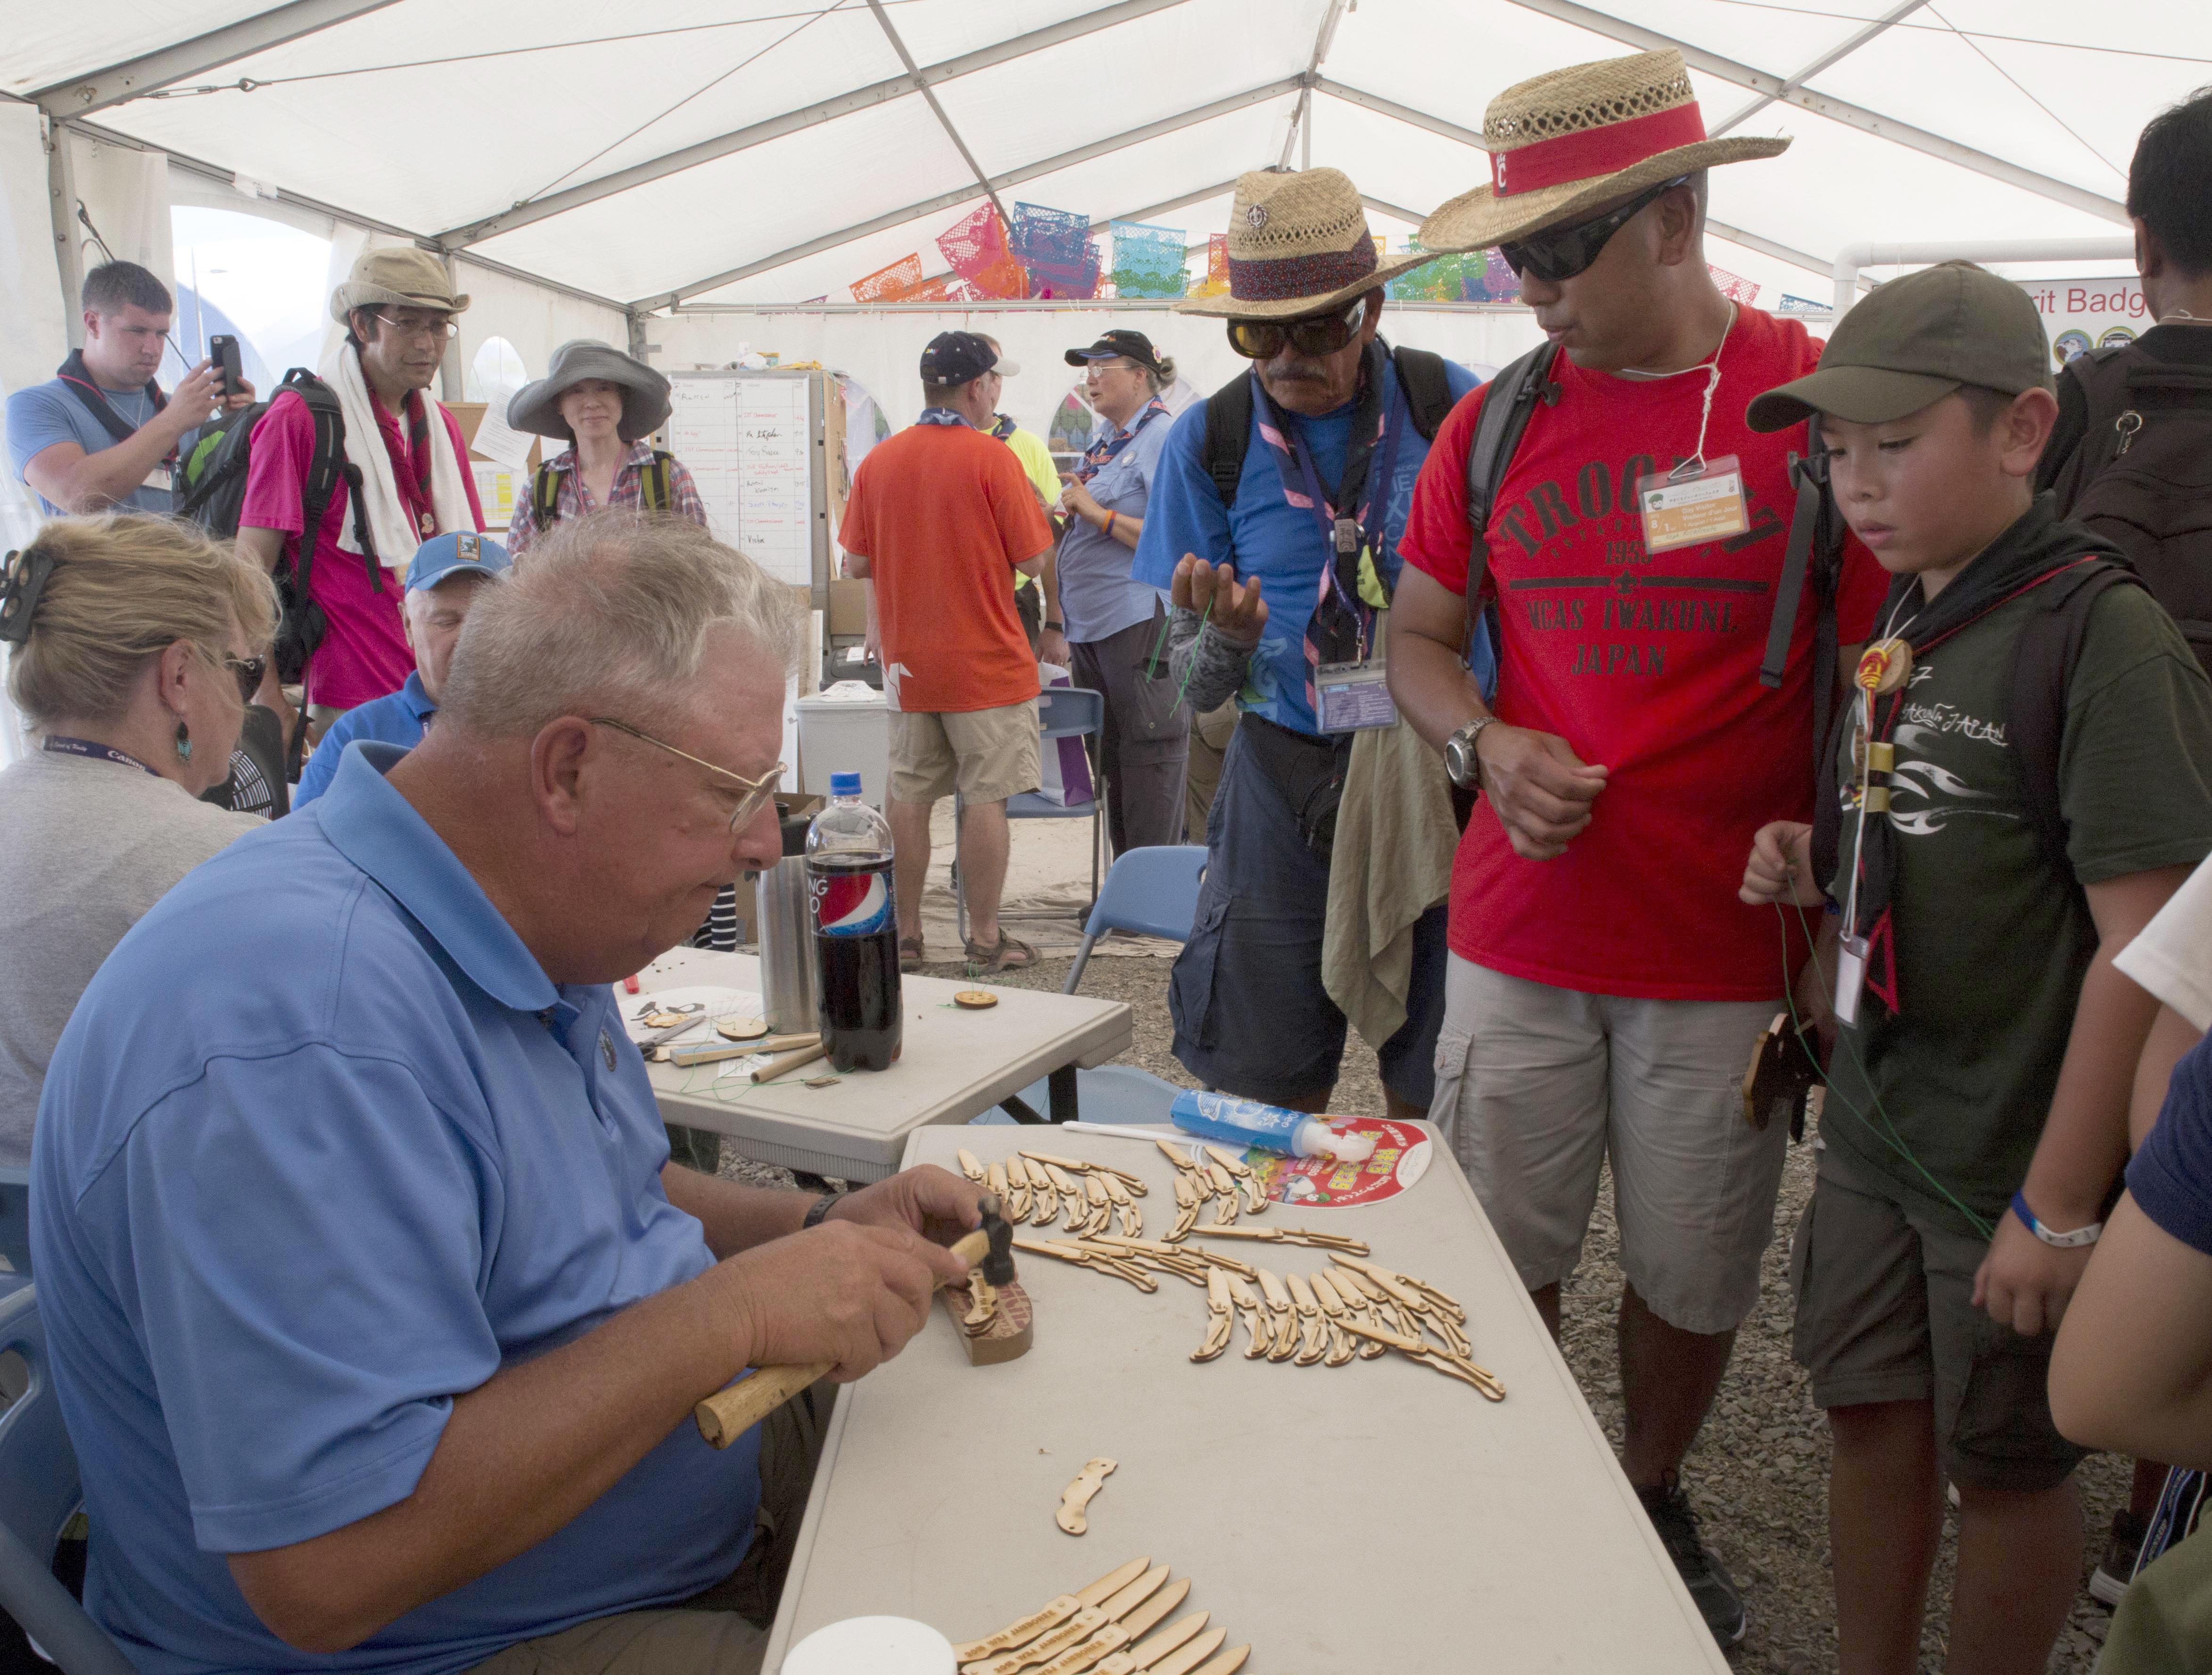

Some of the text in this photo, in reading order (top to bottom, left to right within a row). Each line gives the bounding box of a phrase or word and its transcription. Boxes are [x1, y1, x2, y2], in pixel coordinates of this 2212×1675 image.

[2067, 287, 2146, 318] Badg
[1682, 503, 1716, 515] Day Visitor
[1682, 510, 1706, 520] Visiteur
[1570, 644, 1667, 676] JAPAN
[107, 750, 146, 771] Canon
[1010, 1609, 1057, 1635] JAMBOREE
[1039, 1623, 1084, 1650] JAMBOREE
[1059, 1640, 1105, 1667] JAMBOREE
